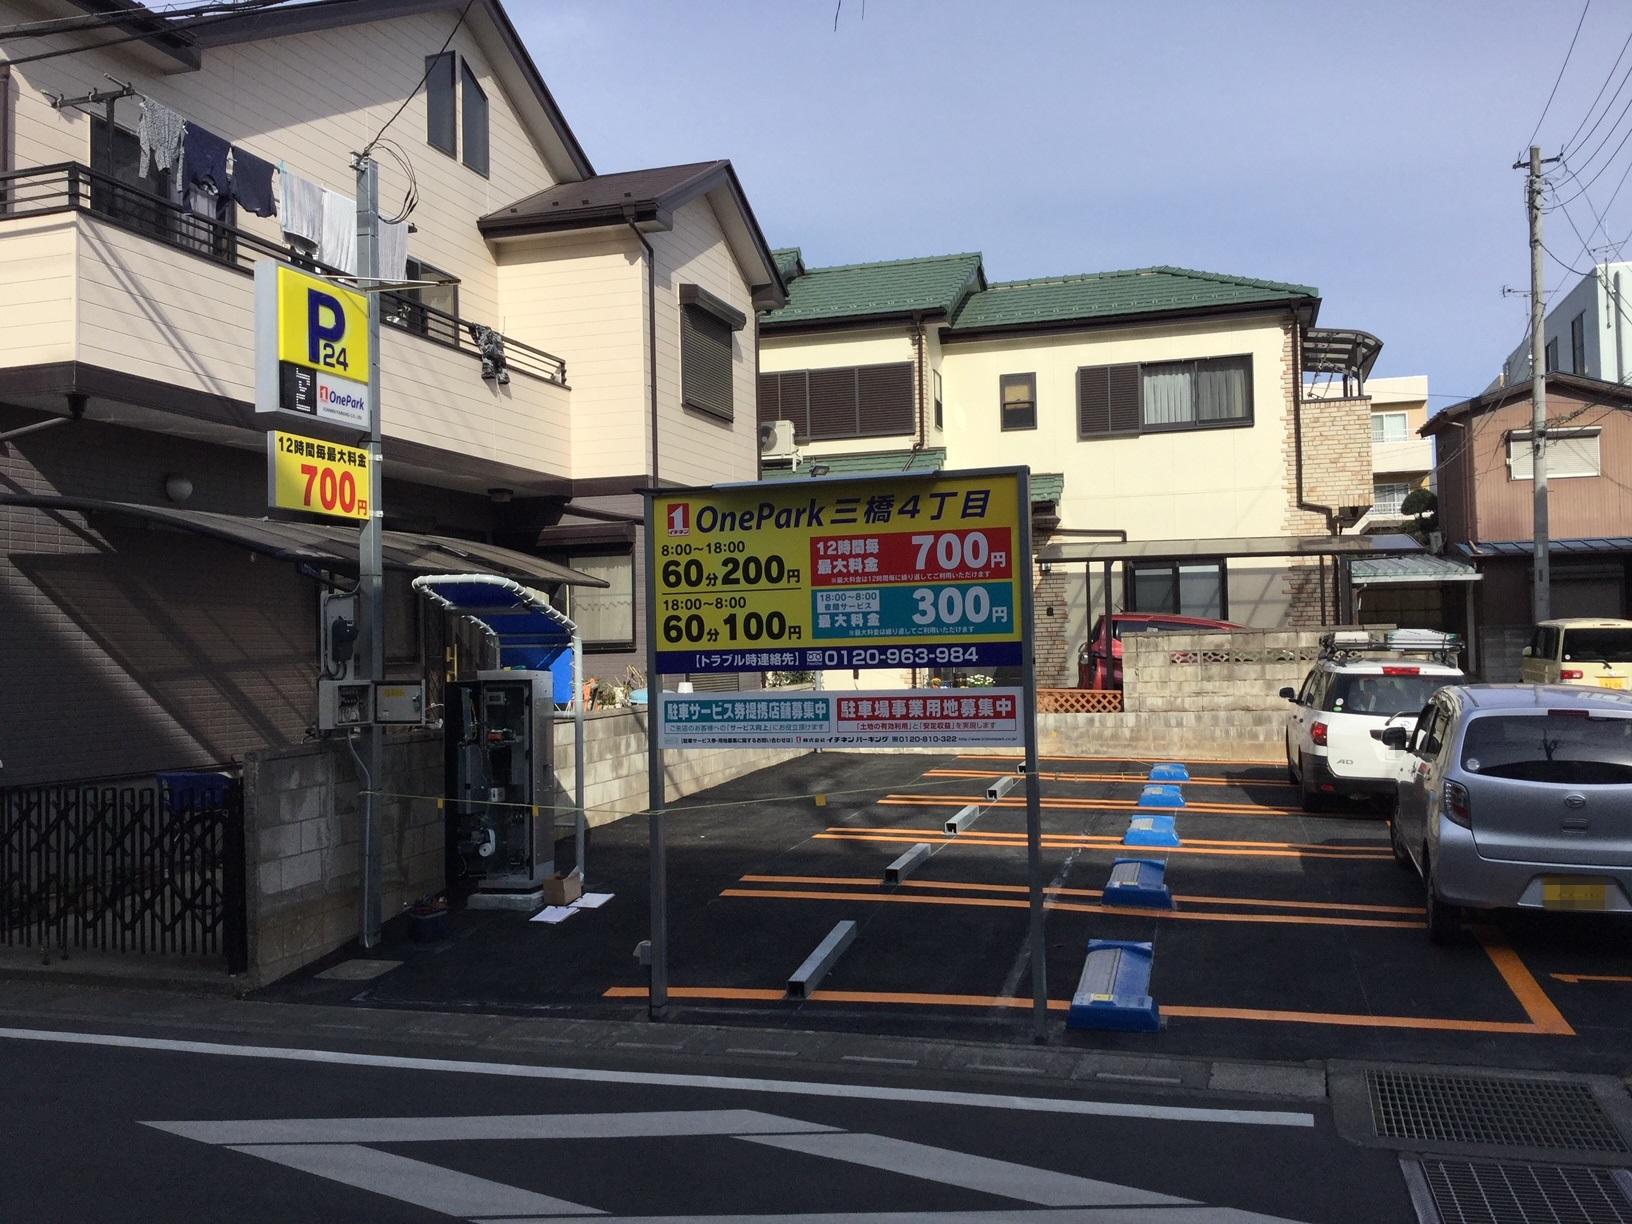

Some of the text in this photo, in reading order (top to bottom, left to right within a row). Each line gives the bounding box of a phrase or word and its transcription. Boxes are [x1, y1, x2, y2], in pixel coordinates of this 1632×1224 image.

[308, 288, 346, 365] P
[323, 342, 349, 372] 24
[329, 390, 365, 411] OnePark
[278, 436, 367, 468] 12時間毎最大料金
[301, 463, 368, 516] 700円
[696, 499, 825, 533] OnePark
[830, 489, 991, 525] 三橋4丁目
[816, 532, 1006, 570] 12時間毎 700円
[817, 556, 879, 575] 最大料金
[818, 586, 1008, 628] 最大料金 300円
[824, 647, 979, 667] 0120-963-984
[667, 700, 828, 721] 駐車サービス券提携店舗募集中
[840, 697, 1012, 719] 駐車場事業用地募集中
[898, 735, 957, 744] 0120-810-322
